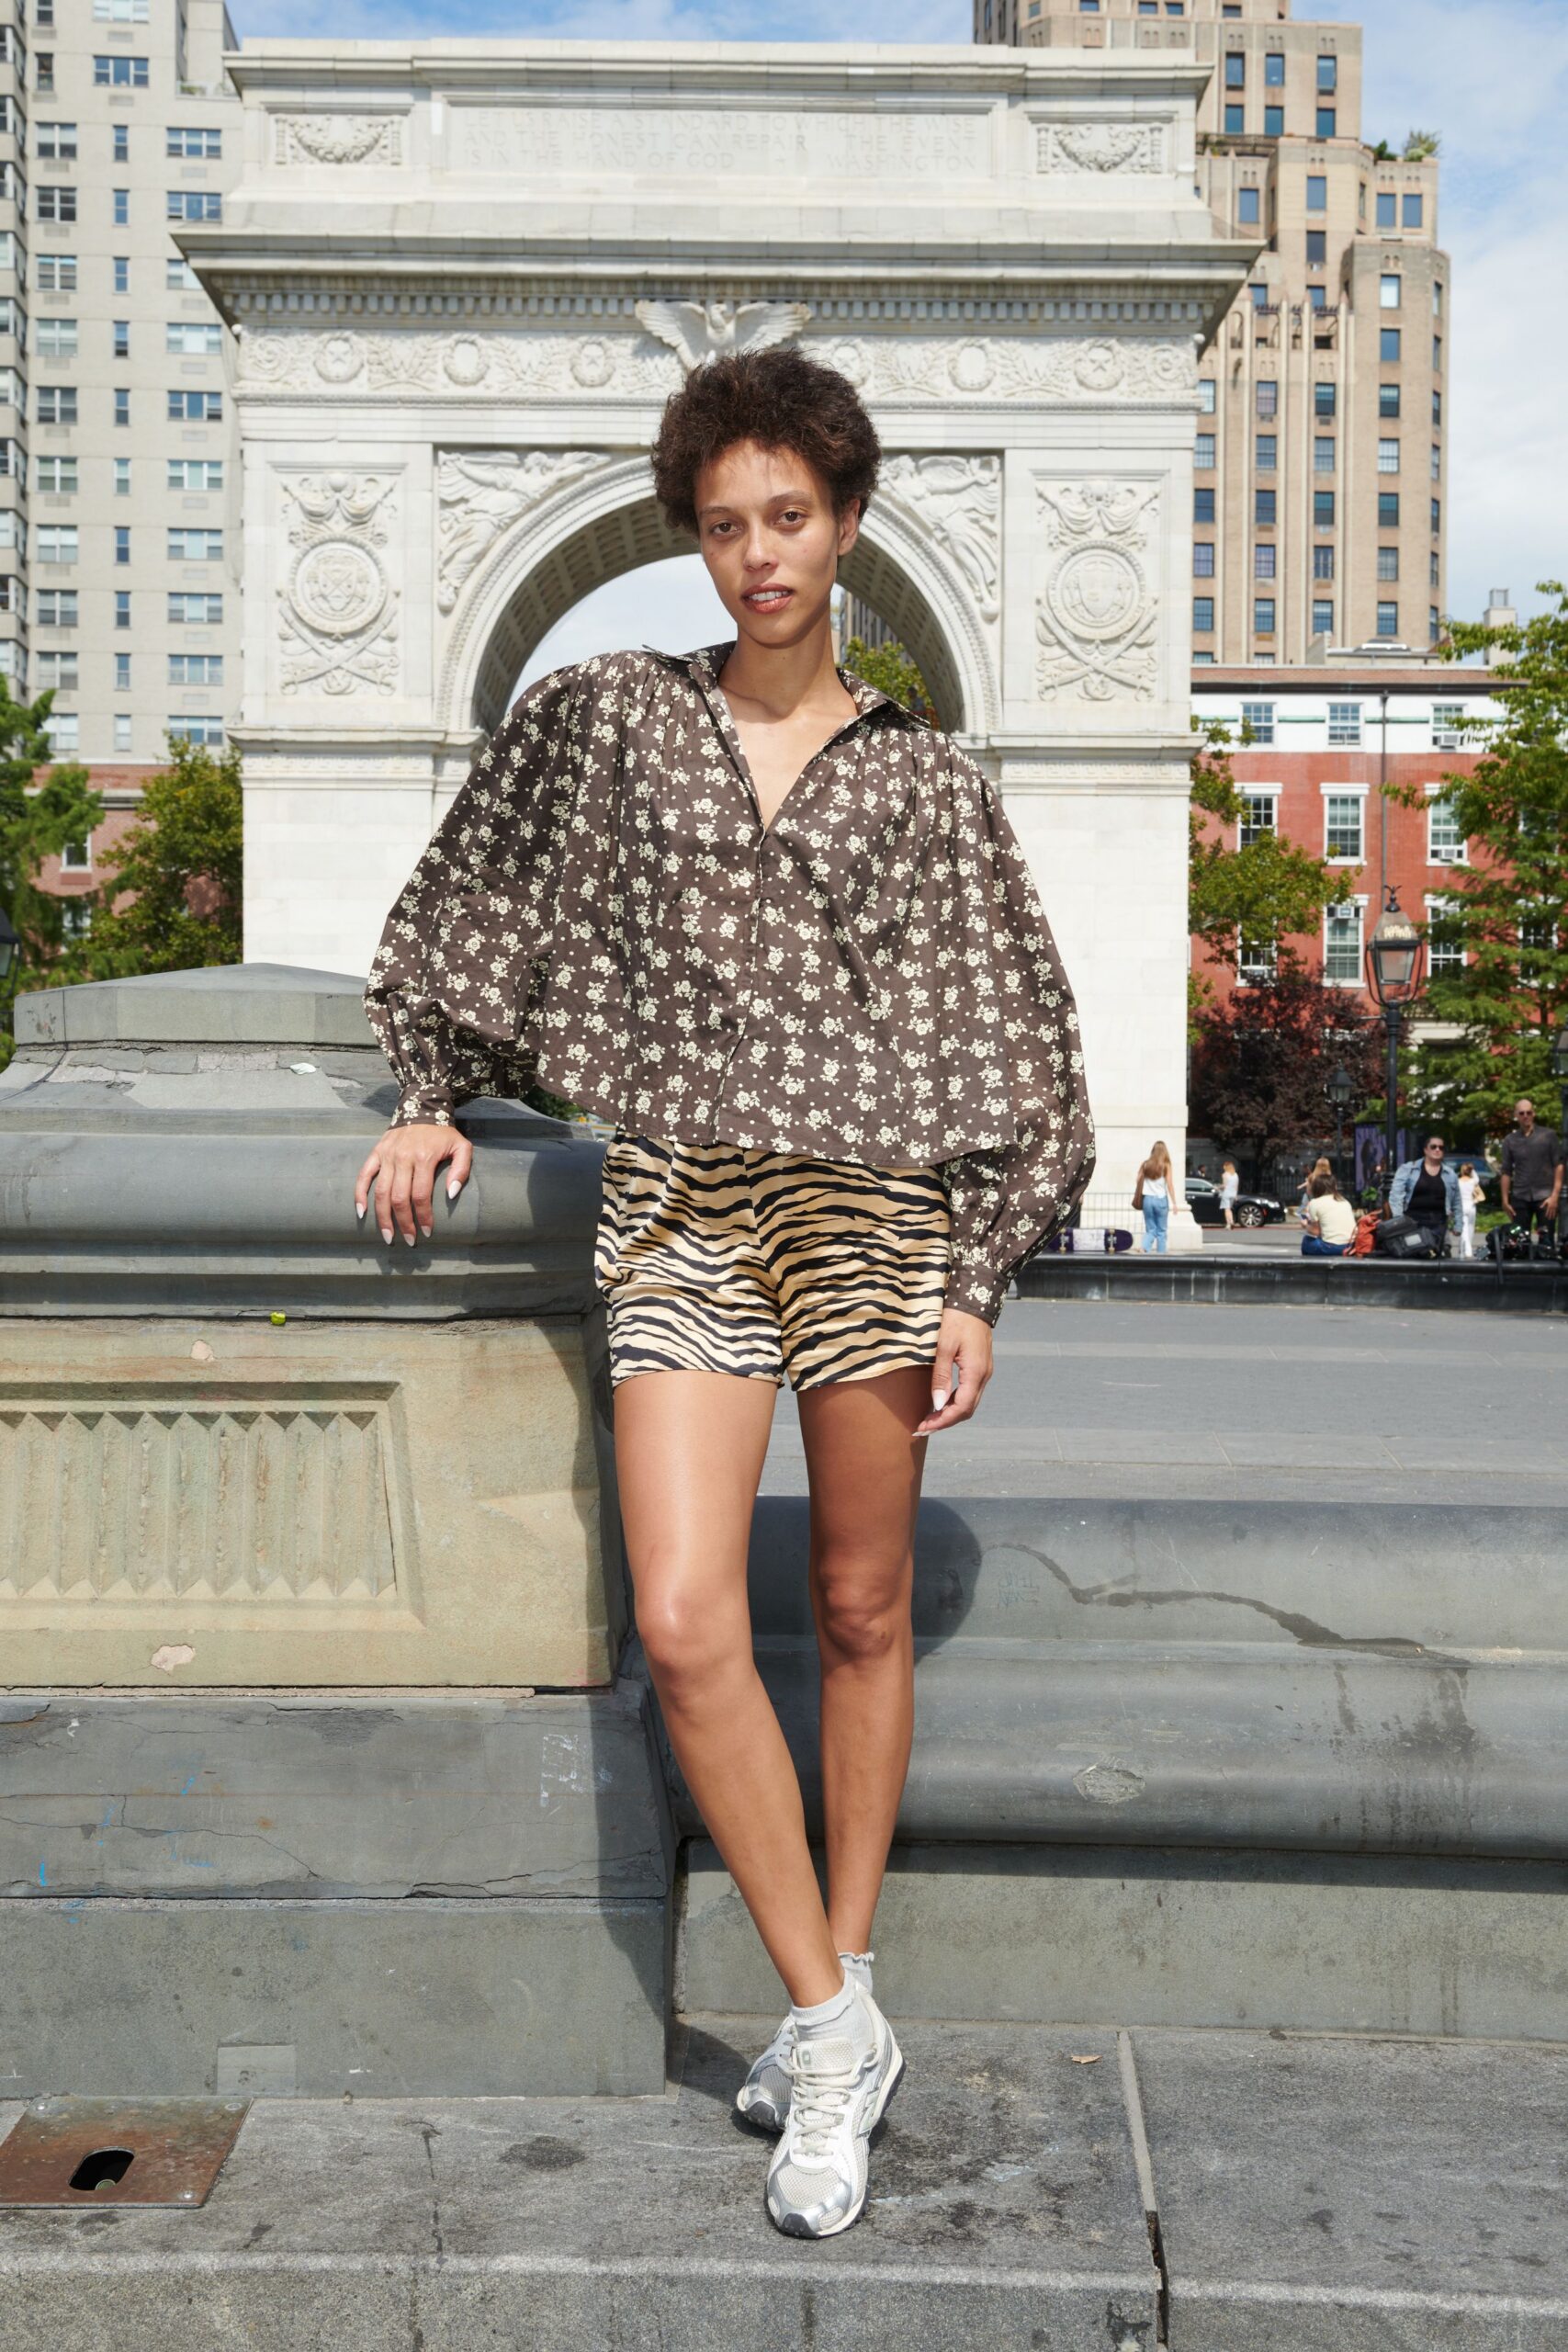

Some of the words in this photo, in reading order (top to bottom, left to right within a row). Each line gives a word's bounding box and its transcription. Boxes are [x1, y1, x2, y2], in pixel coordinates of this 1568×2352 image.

[542, 112, 601, 129] RAISE
[610, 113, 625, 129] A
[633, 113, 749, 130] STANDARD
[758, 114, 786, 131] TO
[874, 116, 916, 132] THE
[463, 130, 507, 146] AND
[515, 130, 558, 147] THE
[572, 131, 661, 149] HONEST
[672, 132, 720, 150] CAN
[731, 133, 807, 151] REPAIR
[845, 134, 887, 152] THE
[902, 135, 976, 153] EVENT
[464, 149, 481, 165] IS
[491, 149, 510, 165] IN
[518, 150, 562, 166] THE
[574, 151, 637, 168] HAND
[647, 151, 677, 169] OF
[686, 152, 735, 169] GOD
[826, 153, 976, 172] WASHINGTON
